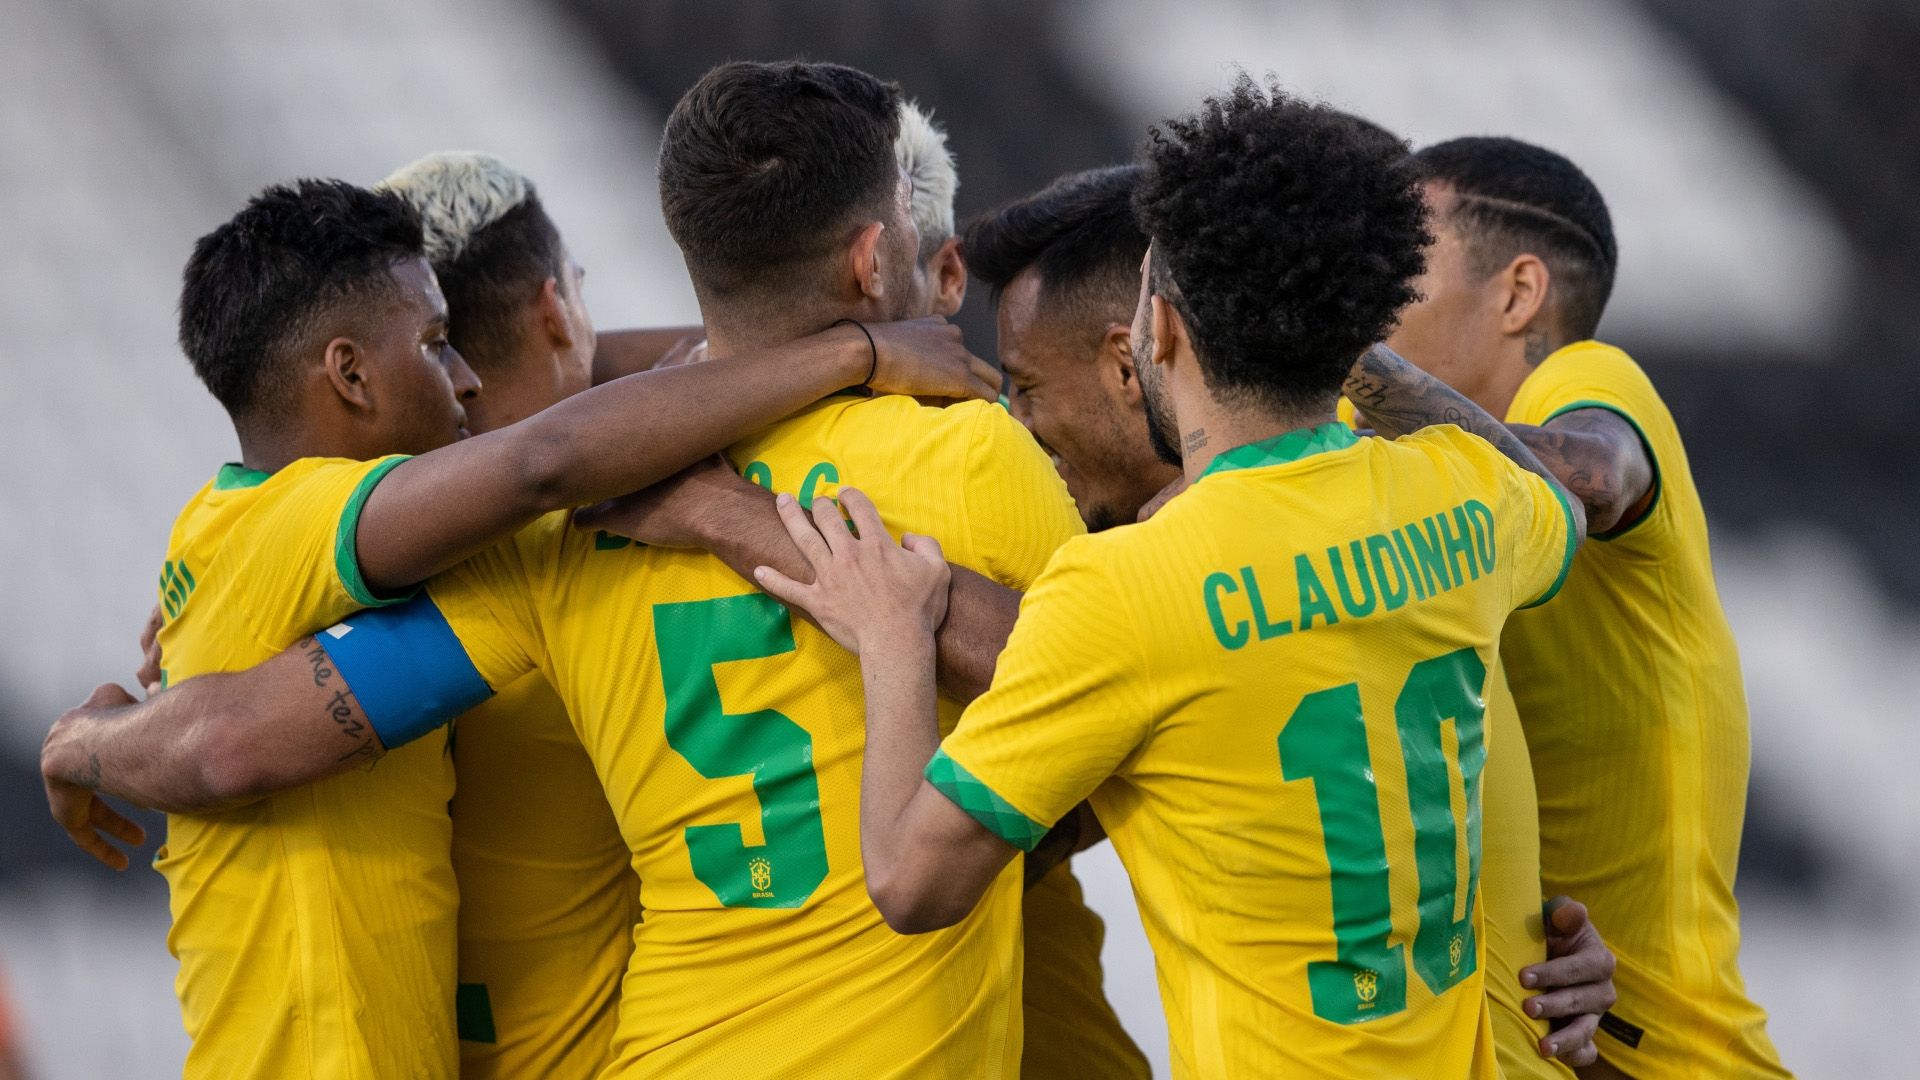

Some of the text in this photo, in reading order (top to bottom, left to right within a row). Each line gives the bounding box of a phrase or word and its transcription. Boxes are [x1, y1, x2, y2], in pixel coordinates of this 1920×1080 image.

[1203, 499, 1496, 650] CLAUDINHO
[653, 591, 829, 909] 5
[1278, 646, 1487, 1025] 10
